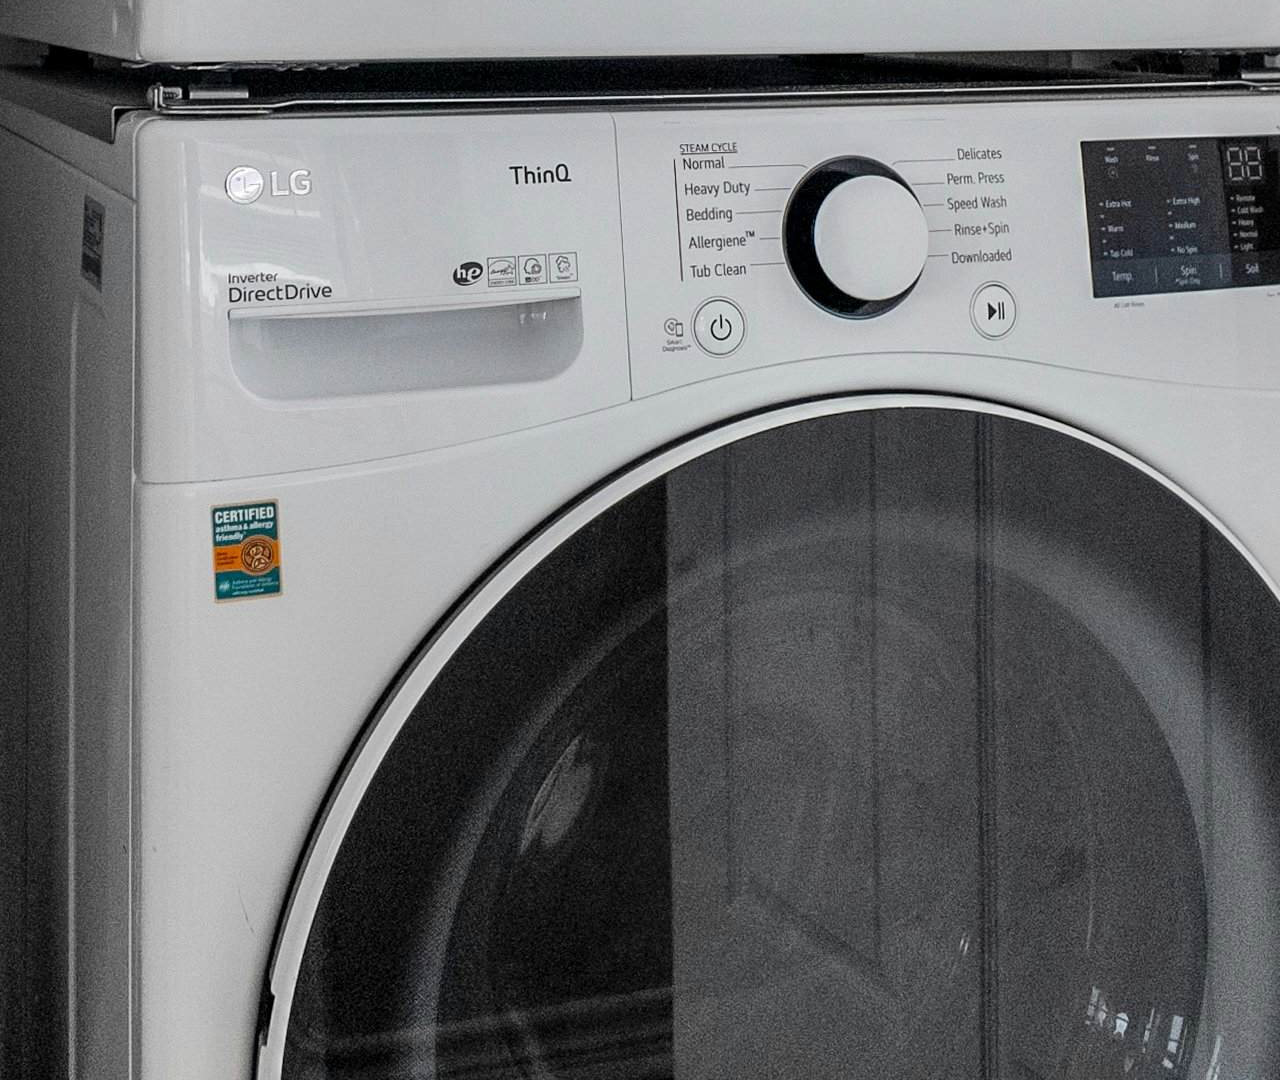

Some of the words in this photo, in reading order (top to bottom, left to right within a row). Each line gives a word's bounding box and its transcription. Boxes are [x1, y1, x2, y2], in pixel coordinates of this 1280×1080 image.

[679, 143, 709, 153] STEAM
[711, 142, 738, 152] CYCLE
[956, 147, 1002, 161] Delicates
[682, 156, 725, 170] Normal
[509, 163, 572, 185] ThinQ
[946, 172, 976, 185] Perm.
[977, 171, 1006, 184] Press
[270, 169, 312, 196] LG
[684, 182, 720, 198] Heavy
[723, 180, 751, 196] Duty
[947, 196, 978, 213] Speed
[980, 194, 1008, 209] Wash
[686, 207, 733, 223] Bedding
[954, 221, 1010, 237] Rinse+Spin
[951, 247, 1012, 264] Downloaded
[227, 272, 278, 284] Inverter
[689, 264, 711, 279] Tub
[714, 262, 747, 277] Clean
[215, 506, 274, 524] CERTIFIED
